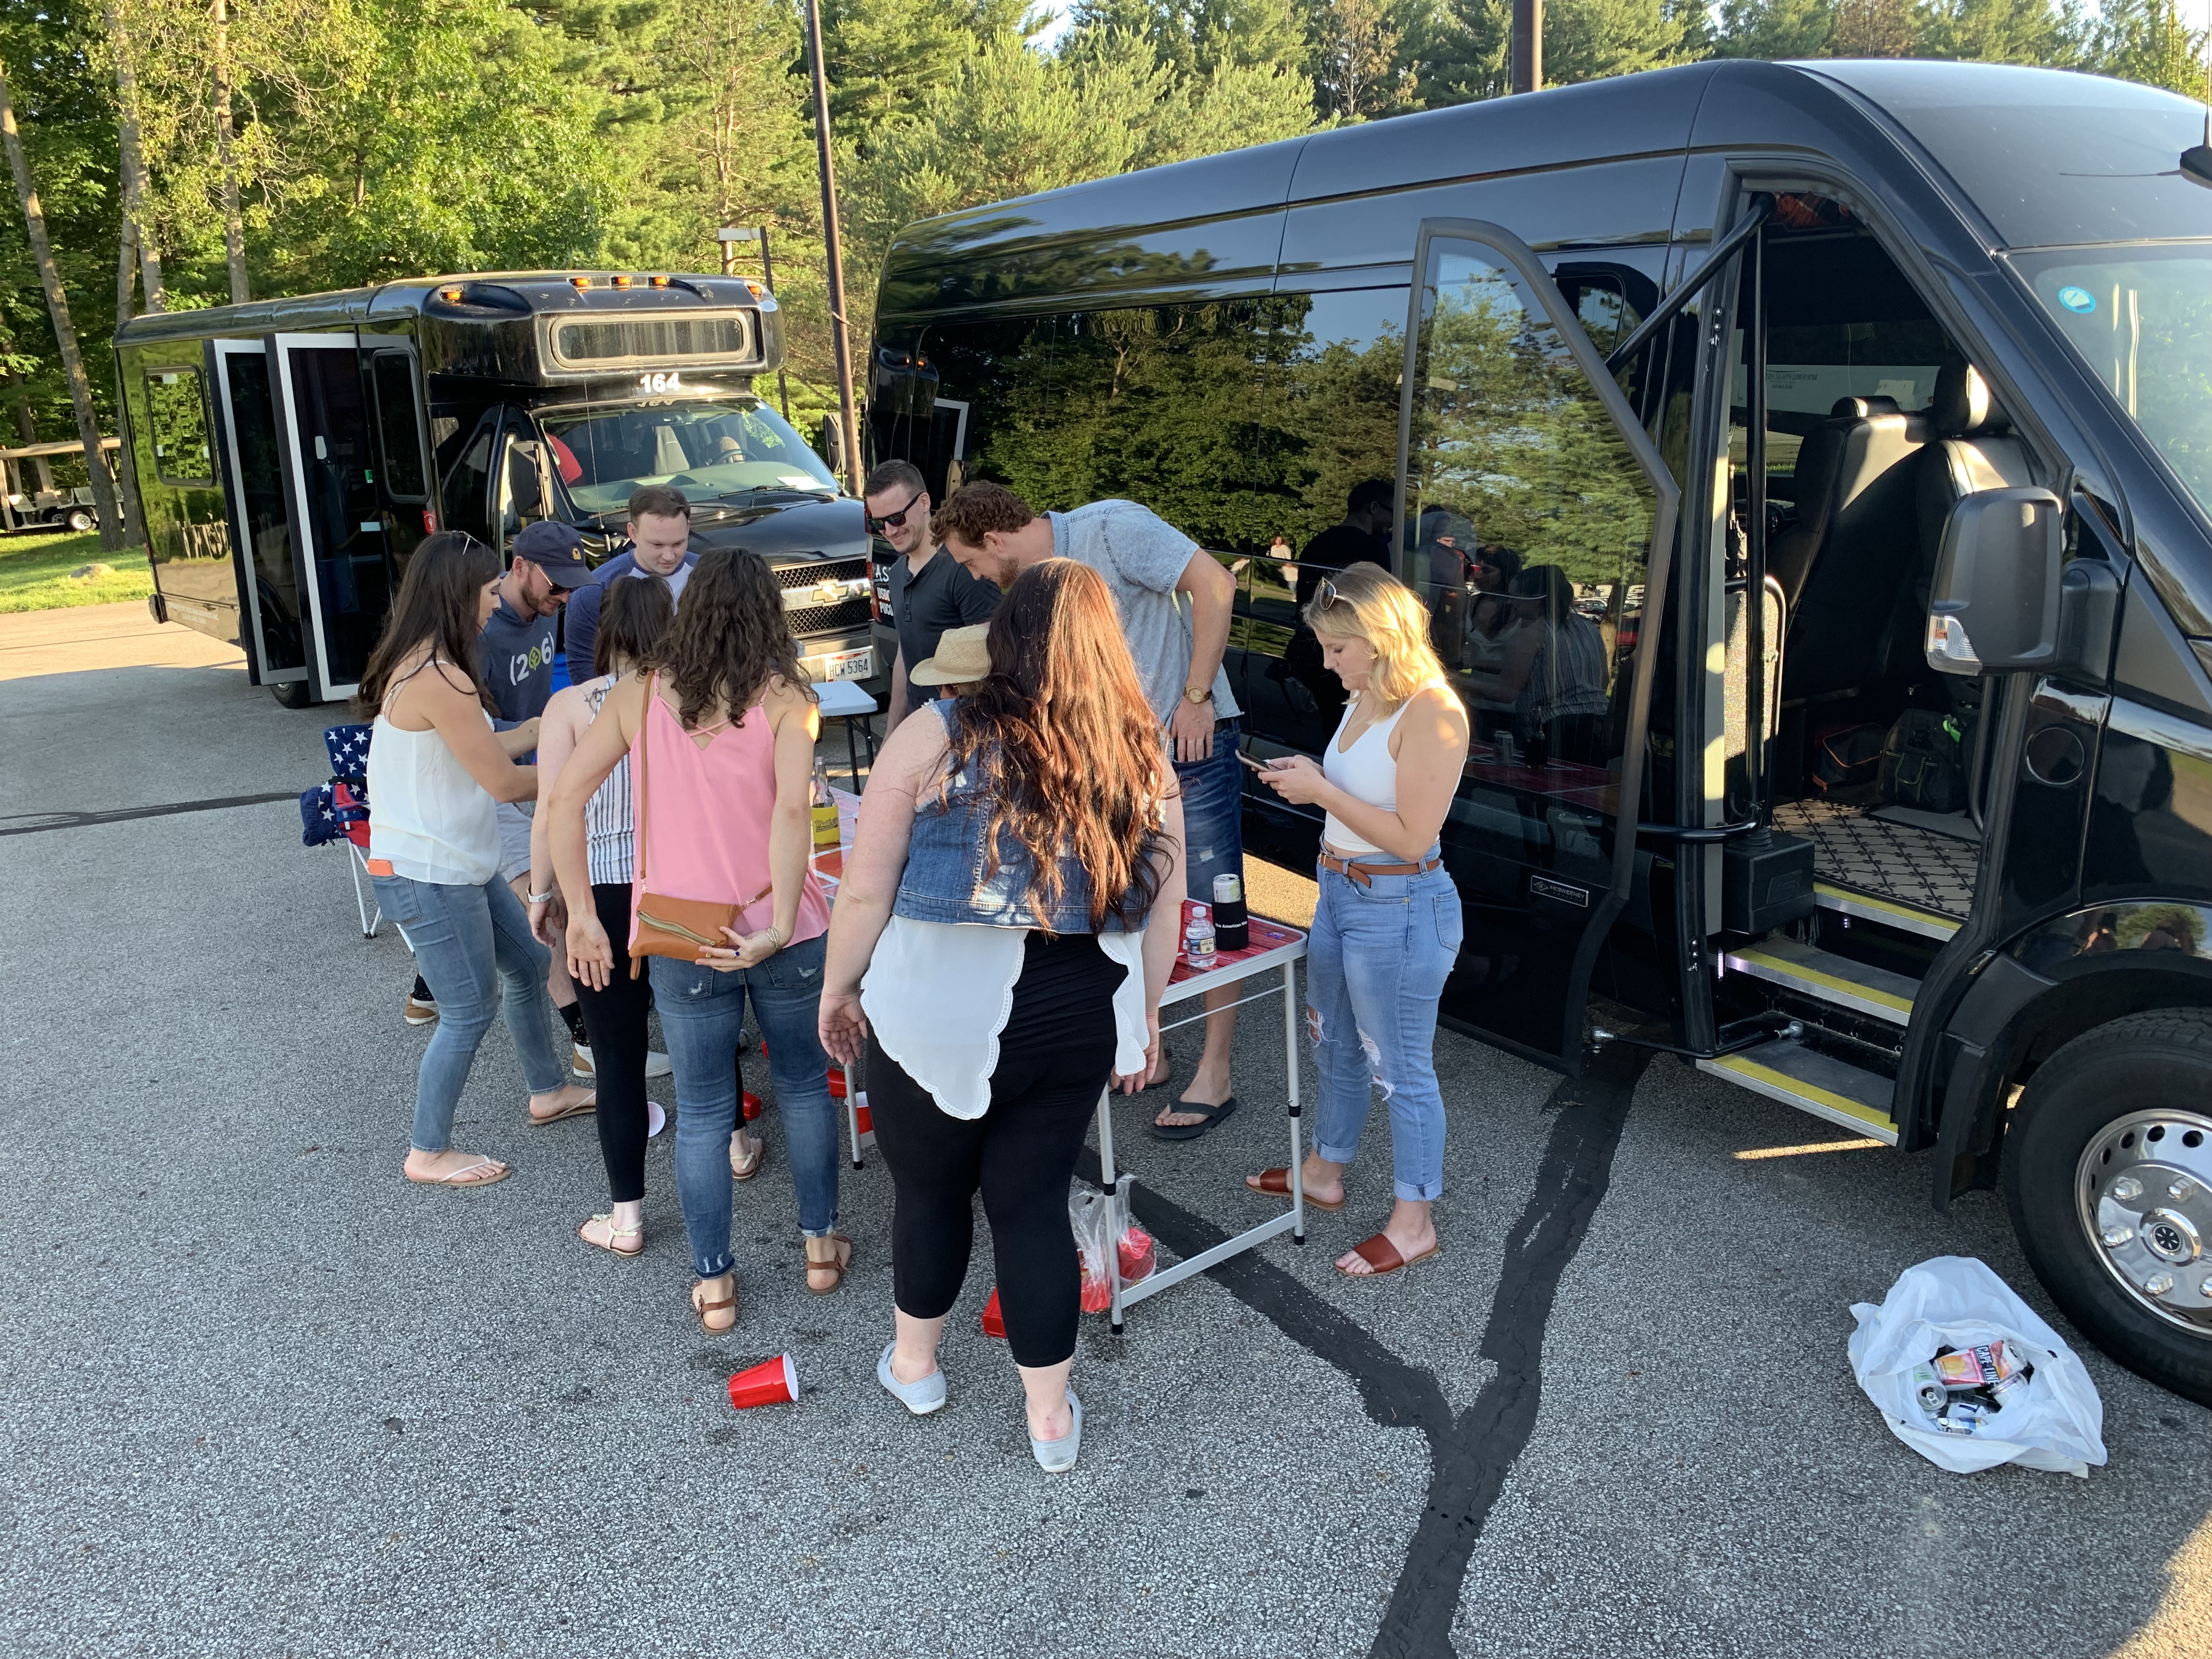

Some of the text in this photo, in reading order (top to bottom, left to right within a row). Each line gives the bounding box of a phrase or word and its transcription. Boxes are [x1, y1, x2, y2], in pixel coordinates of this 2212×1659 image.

[640, 372, 680, 393] 164
[875, 564, 891, 582] AS
[848, 658, 868, 674] 5364
[1976, 1346, 1993, 1364] CAPE
[1984, 1367, 2000, 1385] LINE
